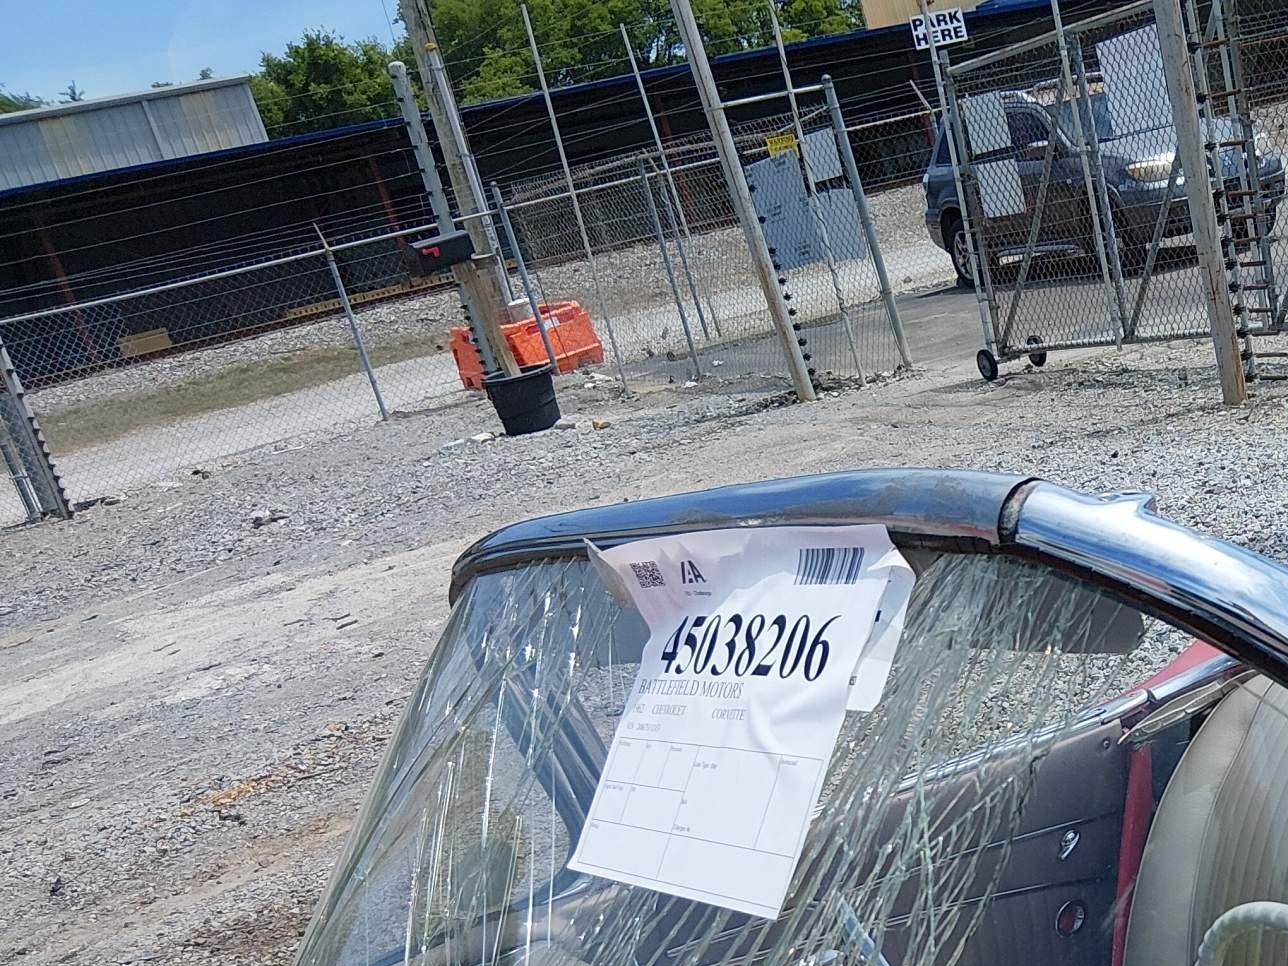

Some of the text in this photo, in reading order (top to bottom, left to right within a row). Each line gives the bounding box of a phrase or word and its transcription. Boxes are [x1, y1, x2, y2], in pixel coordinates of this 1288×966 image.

[915, 26, 965, 47] HERE
[660, 614, 842, 681] 45038206
[700, 680, 745, 699] MOTORS
